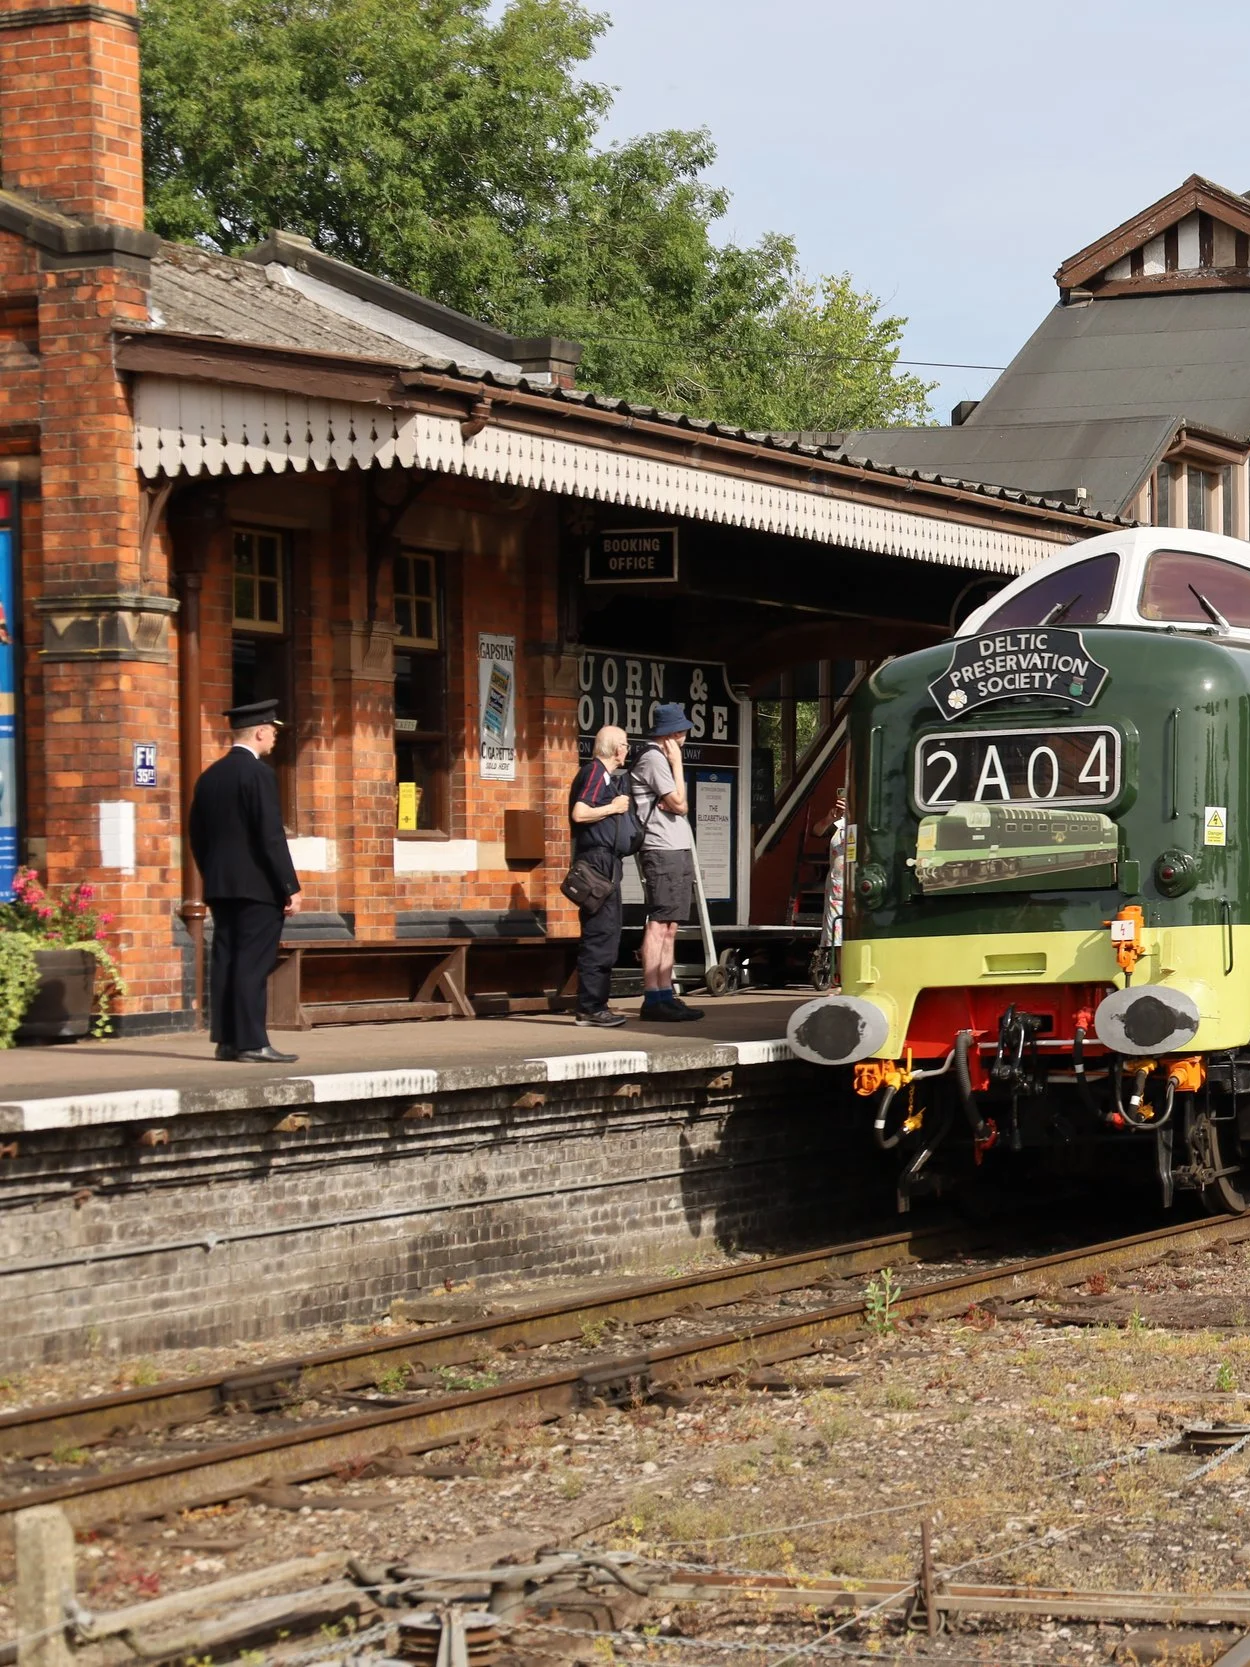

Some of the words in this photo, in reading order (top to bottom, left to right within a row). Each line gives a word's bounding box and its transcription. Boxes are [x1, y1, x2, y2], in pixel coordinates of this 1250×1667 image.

[603, 538, 660, 552] BOOKING
[609, 556, 656, 570] OFFICE
[480, 642, 514, 661] CAPSTAN
[979, 634, 1048, 657] DELTIC
[578, 655, 665, 698] UORN
[689, 668, 708, 701] &
[949, 652, 1089, 688] PRESERVATION
[977, 672, 1058, 697] SOCIETY
[136, 746, 154, 766] FH
[926, 735, 1110, 805] 2A04
[709, 804, 719, 813] THE
